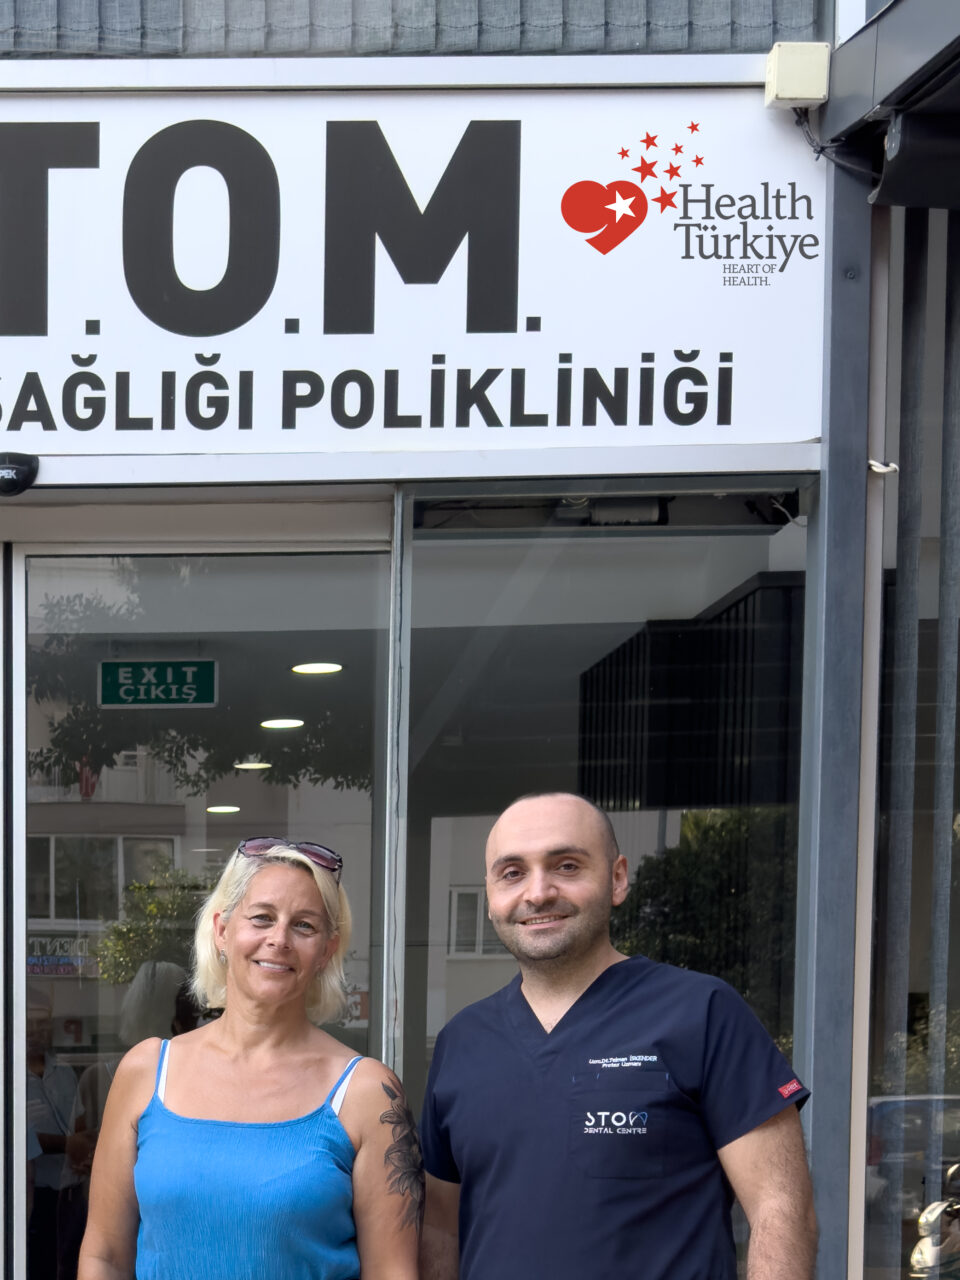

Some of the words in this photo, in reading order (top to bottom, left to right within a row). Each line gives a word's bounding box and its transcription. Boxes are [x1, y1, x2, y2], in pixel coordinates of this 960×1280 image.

[679, 182, 814, 220] Health
[673, 221, 820, 272] Türkiye
[722, 263, 760, 274] HEART
[762, 263, 777, 274] OF
[722, 276, 771, 287] HEALTH.
[281, 349, 733, 430] POLİKLİNİĞİ
[118, 666, 198, 684] EXIT
[118, 684, 198, 703] ÇIKIŞ
[616, 1127, 648, 1135] CENTRE
